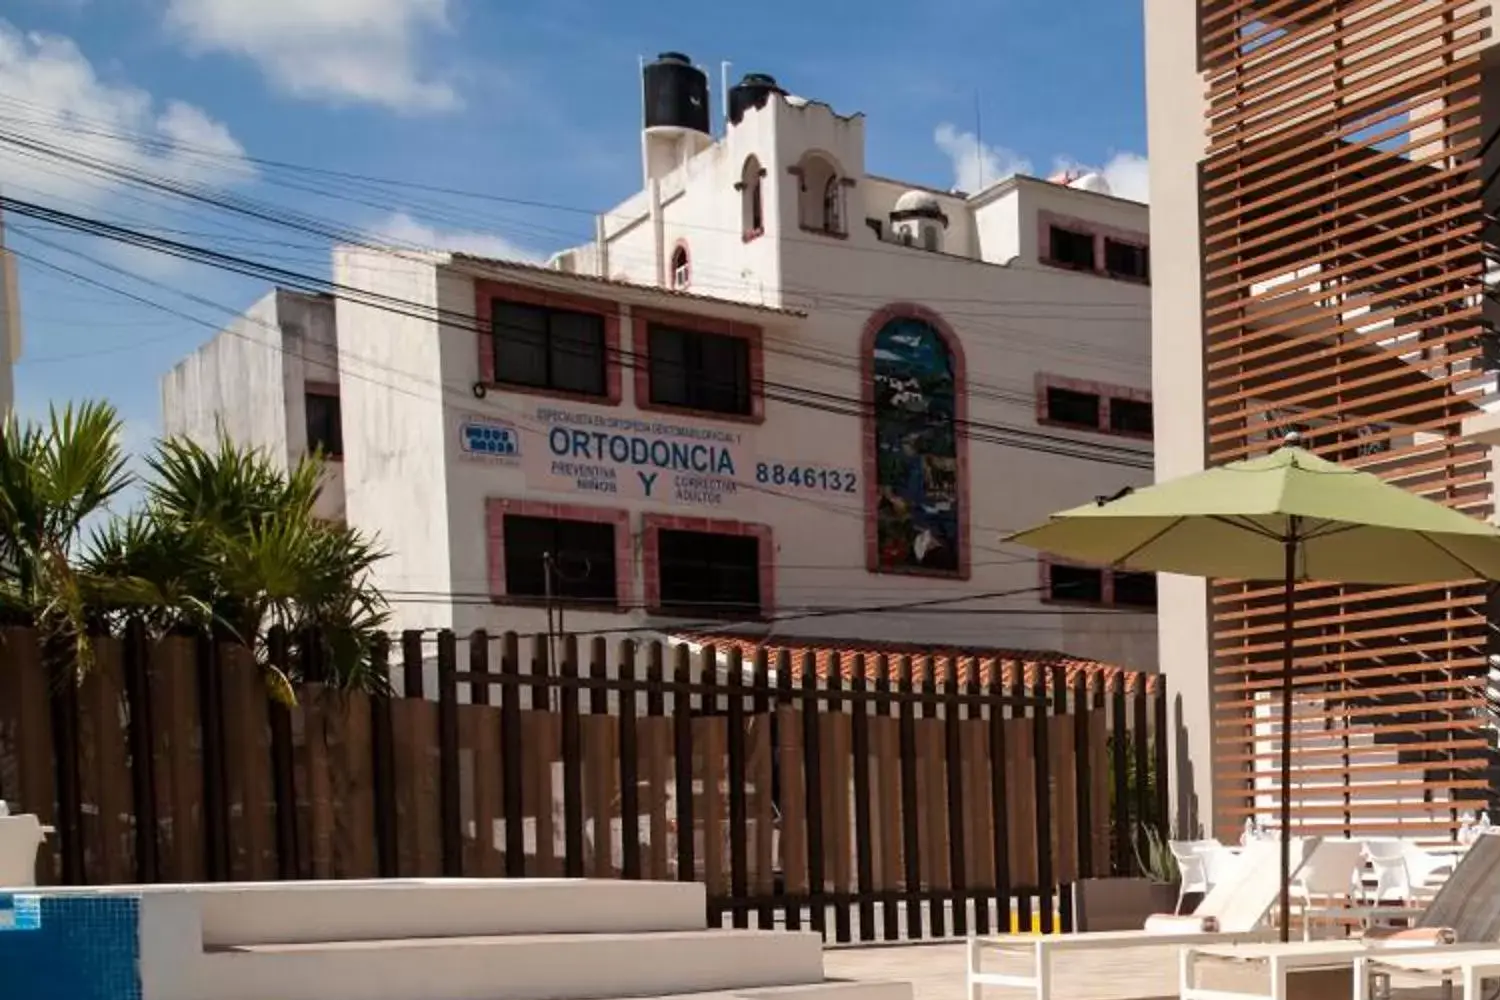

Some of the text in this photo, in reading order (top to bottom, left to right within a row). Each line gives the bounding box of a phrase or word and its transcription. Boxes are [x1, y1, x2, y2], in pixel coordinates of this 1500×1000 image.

[549, 426, 735, 475] ORTODONCIA
[551, 460, 617, 479] PREVENTIVA
[756, 462, 856, 493] 8846132
[636, 470, 658, 497] Y
[674, 475, 737, 495] CORRECTIVA
[675, 489, 722, 505] ADULTOS
